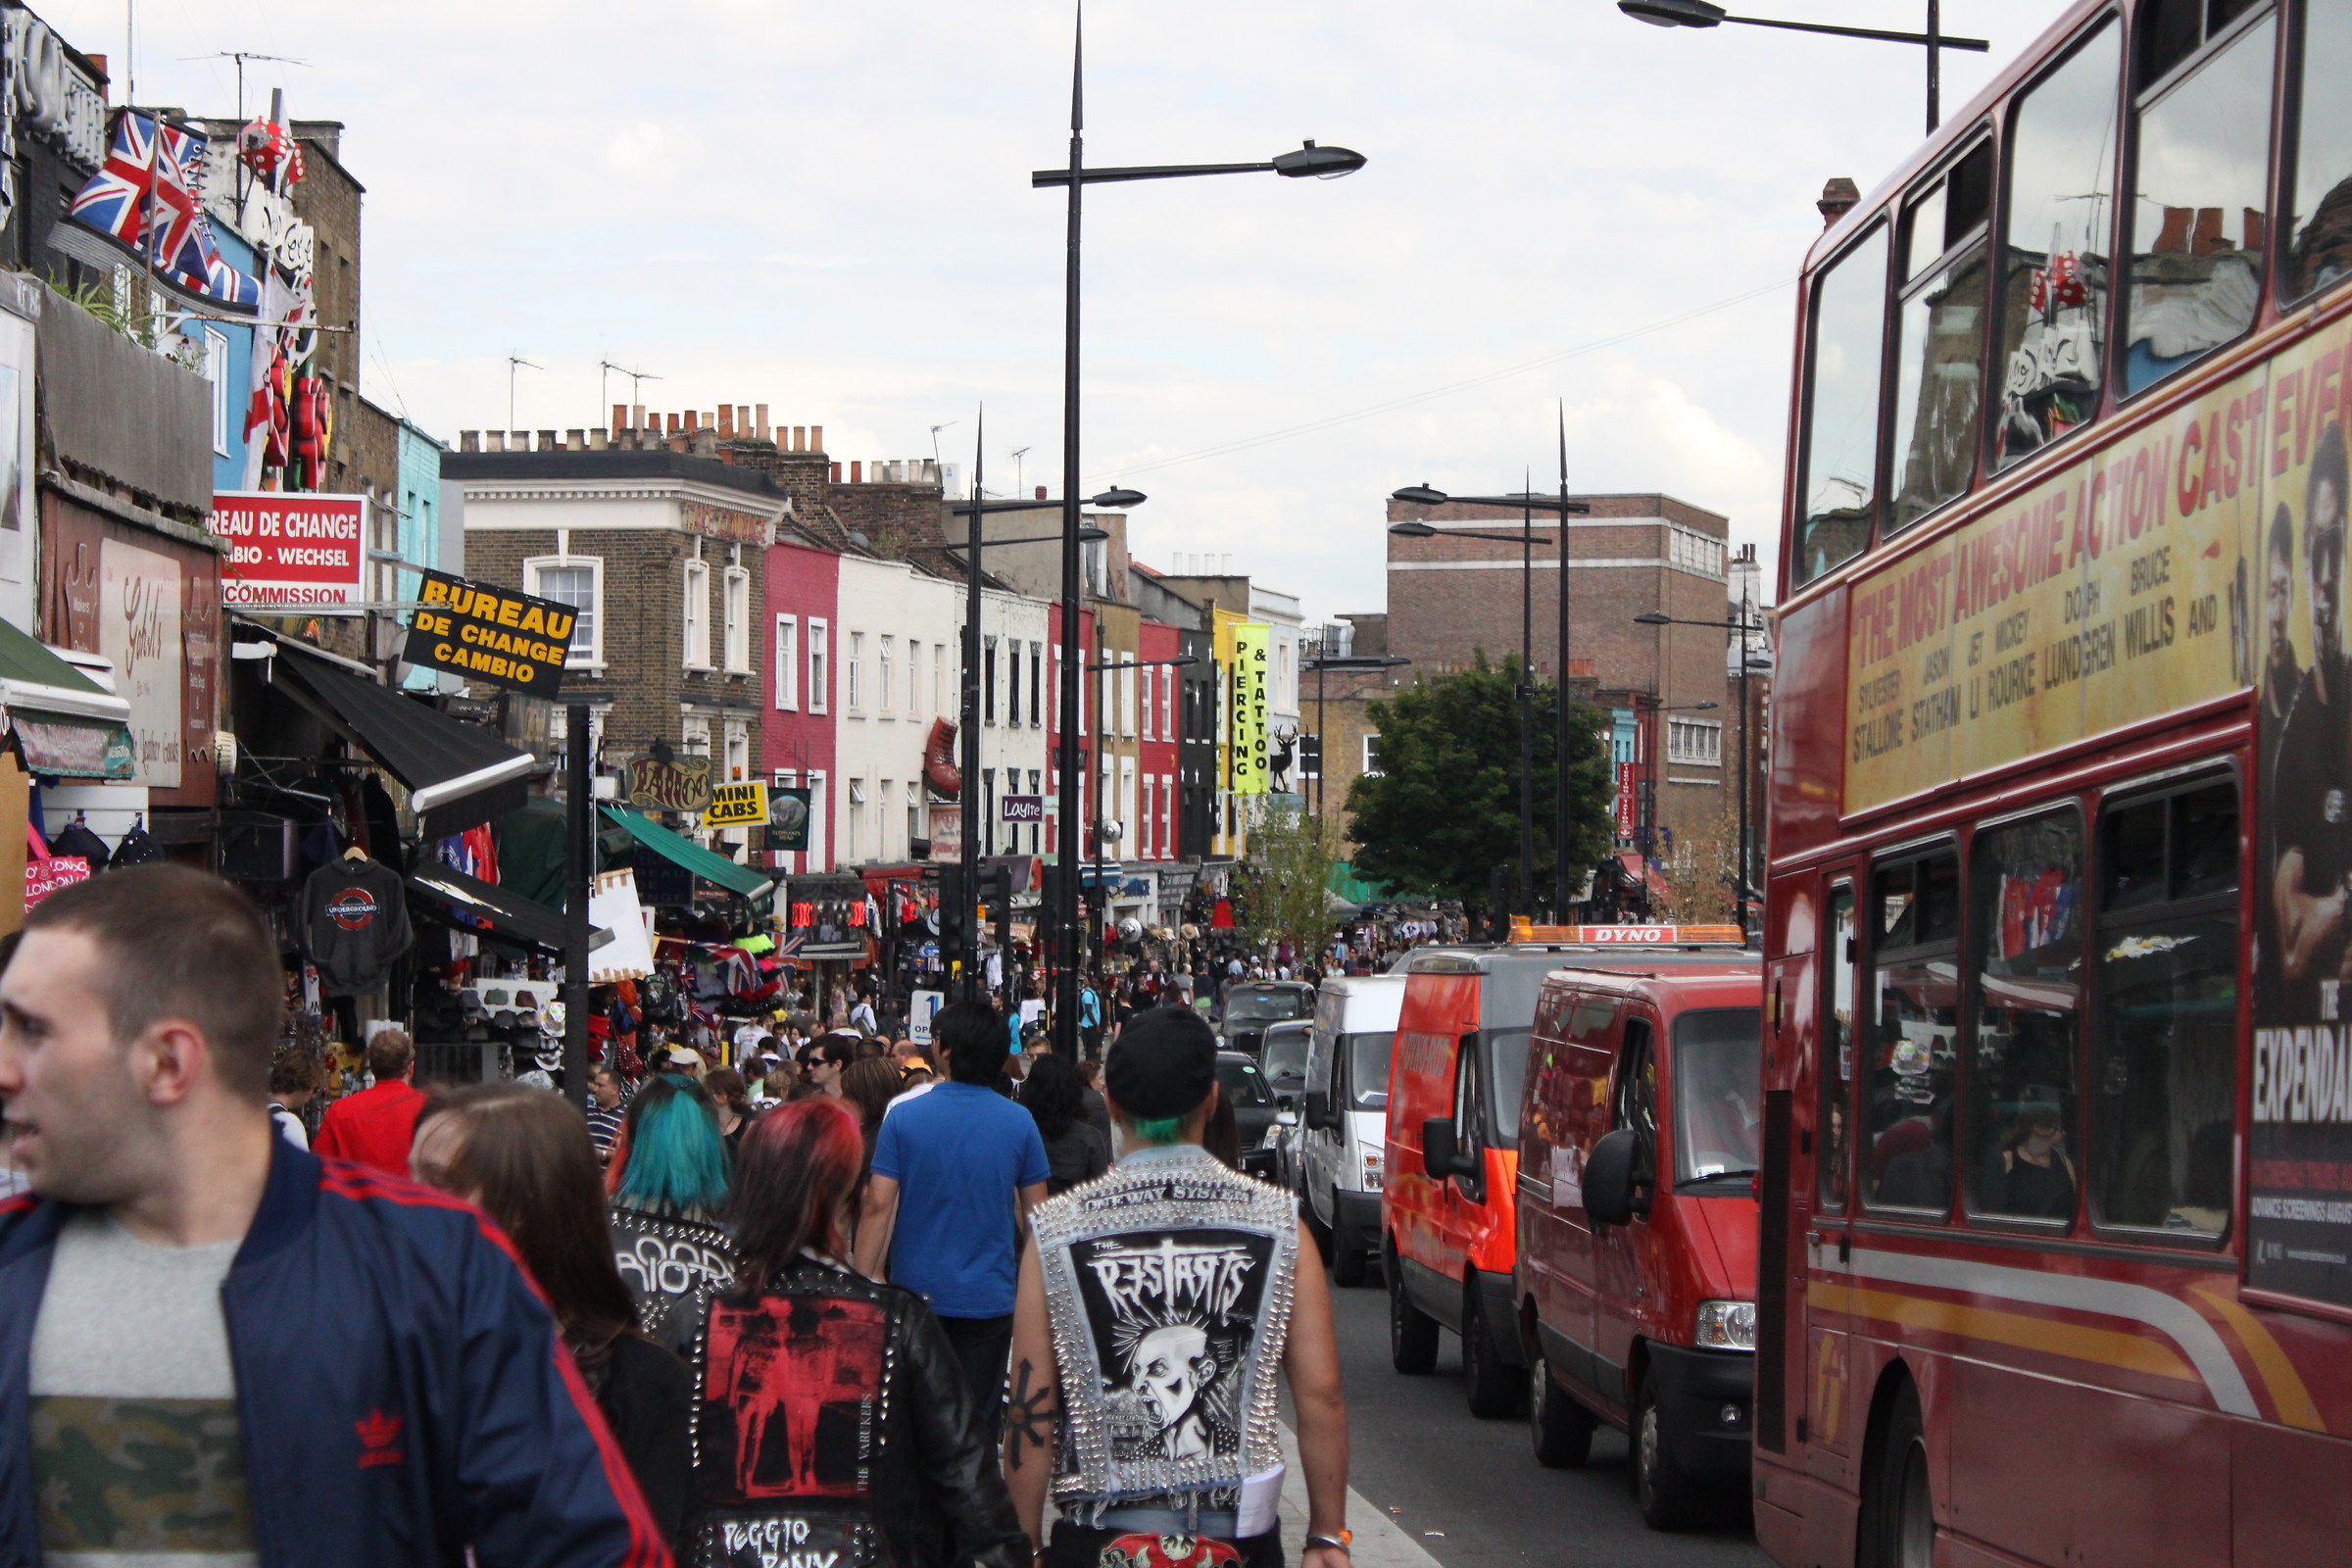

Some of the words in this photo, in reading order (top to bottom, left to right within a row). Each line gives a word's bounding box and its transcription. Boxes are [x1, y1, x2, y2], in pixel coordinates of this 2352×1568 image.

[260, 512, 280, 536] DE
[285, 513, 357, 539] CHANGE
[1898, 551, 1952, 651] MOST
[1954, 490, 2067, 624] AWESOME
[2069, 433, 2173, 568] ACTION
[2178, 385, 2265, 516] CAST
[277, 548, 349, 566] WECHSEL
[224, 586, 346, 603] COMMISSION
[423, 579, 573, 640] BUREAU
[1969, 631, 1984, 666] JET
[2131, 545, 2171, 597] BRUCE
[416, 612, 452, 637] DE
[461, 623, 565, 666] CHANGE
[1254, 648, 1266, 662] &
[434, 642, 535, 683] CAMBIO
[1853, 709, 1904, 763] STALLONE
[1970, 676, 1980, 720] LI
[1988, 652, 2036, 712] ROURKE
[2044, 619, 2116, 690] LUNDGREN
[2124, 596, 2176, 661] WILLIS
[2187, 594, 2218, 638] AND
[1236, 641, 1249, 775] PIERCING
[1254, 670, 1267, 769] TATTOO
[632, 757, 710, 810] TATTOO
[712, 785, 756, 803] MINI
[710, 801, 758, 819] CABS
[25, 874, 74, 897] LONDON
[328, 905, 377, 913] UNDERGROUND
[1594, 928, 1662, 942] DYNO
[2321, 979, 2341, 1020] THE
[2253, 1024, 2352, 1122] EXPENDA
[1127, 1188, 1168, 1206] WAY
[1173, 1185, 1250, 1202] SYSTEM
[1092, 1241, 1124, 1250] THE
[858, 1393, 872, 1460] VARUKERS
[857, 1466, 869, 1492] THE
